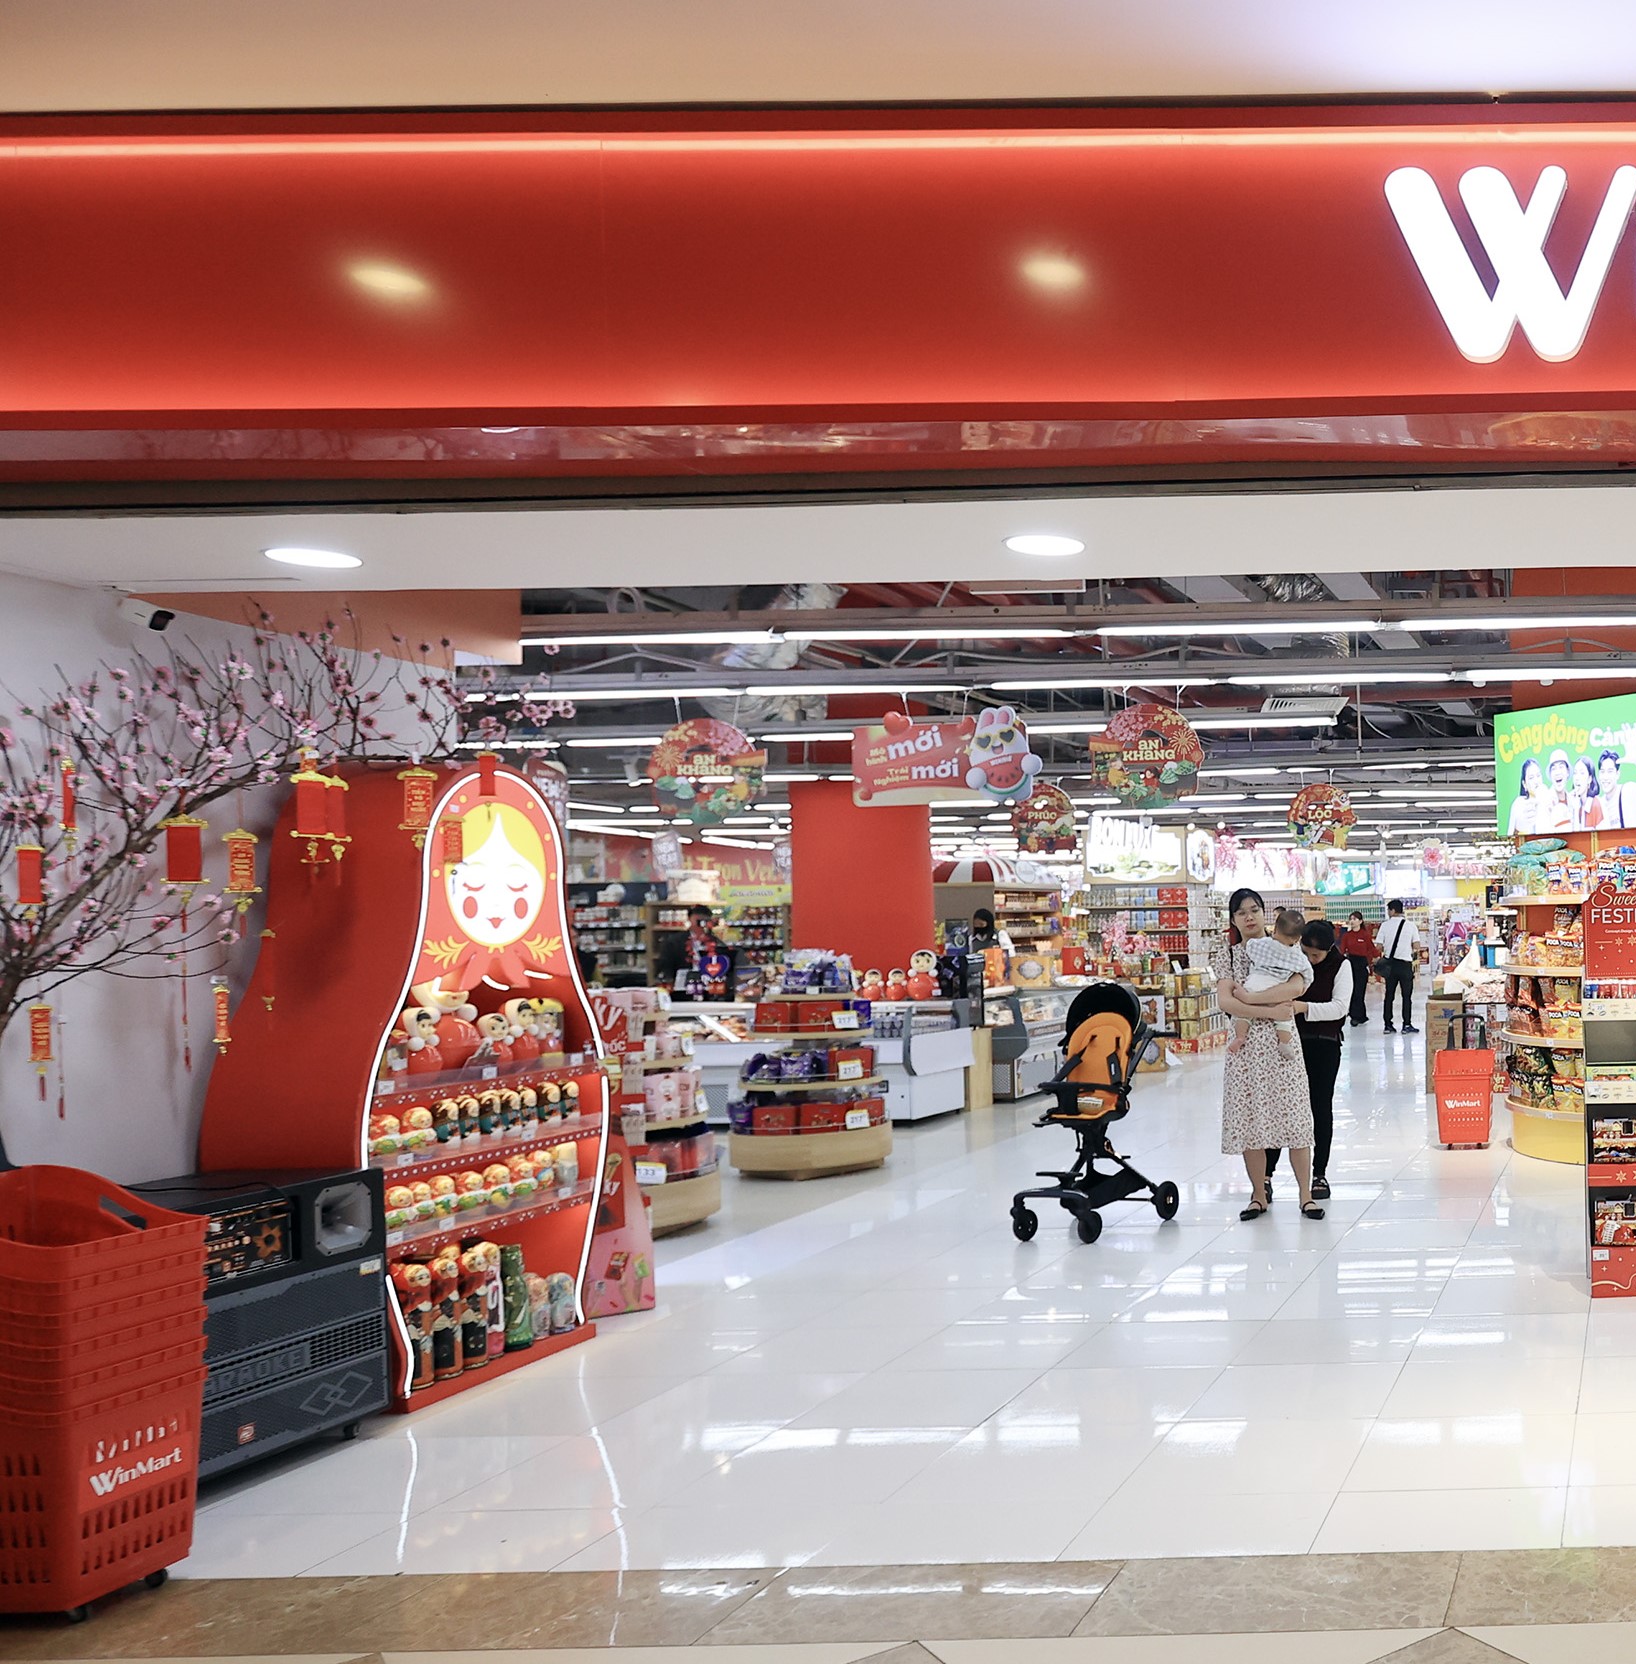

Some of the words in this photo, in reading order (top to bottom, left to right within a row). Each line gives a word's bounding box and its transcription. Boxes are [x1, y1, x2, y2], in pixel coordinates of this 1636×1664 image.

[886, 725, 944, 761] mới
[911, 757, 960, 780] mới
[1027, 809, 1057, 820] PHÚC
[1307, 807, 1333, 822] LỘC
[1445, 1100, 1481, 1109] WinMart
[89, 1447, 182, 1497] WinMart
